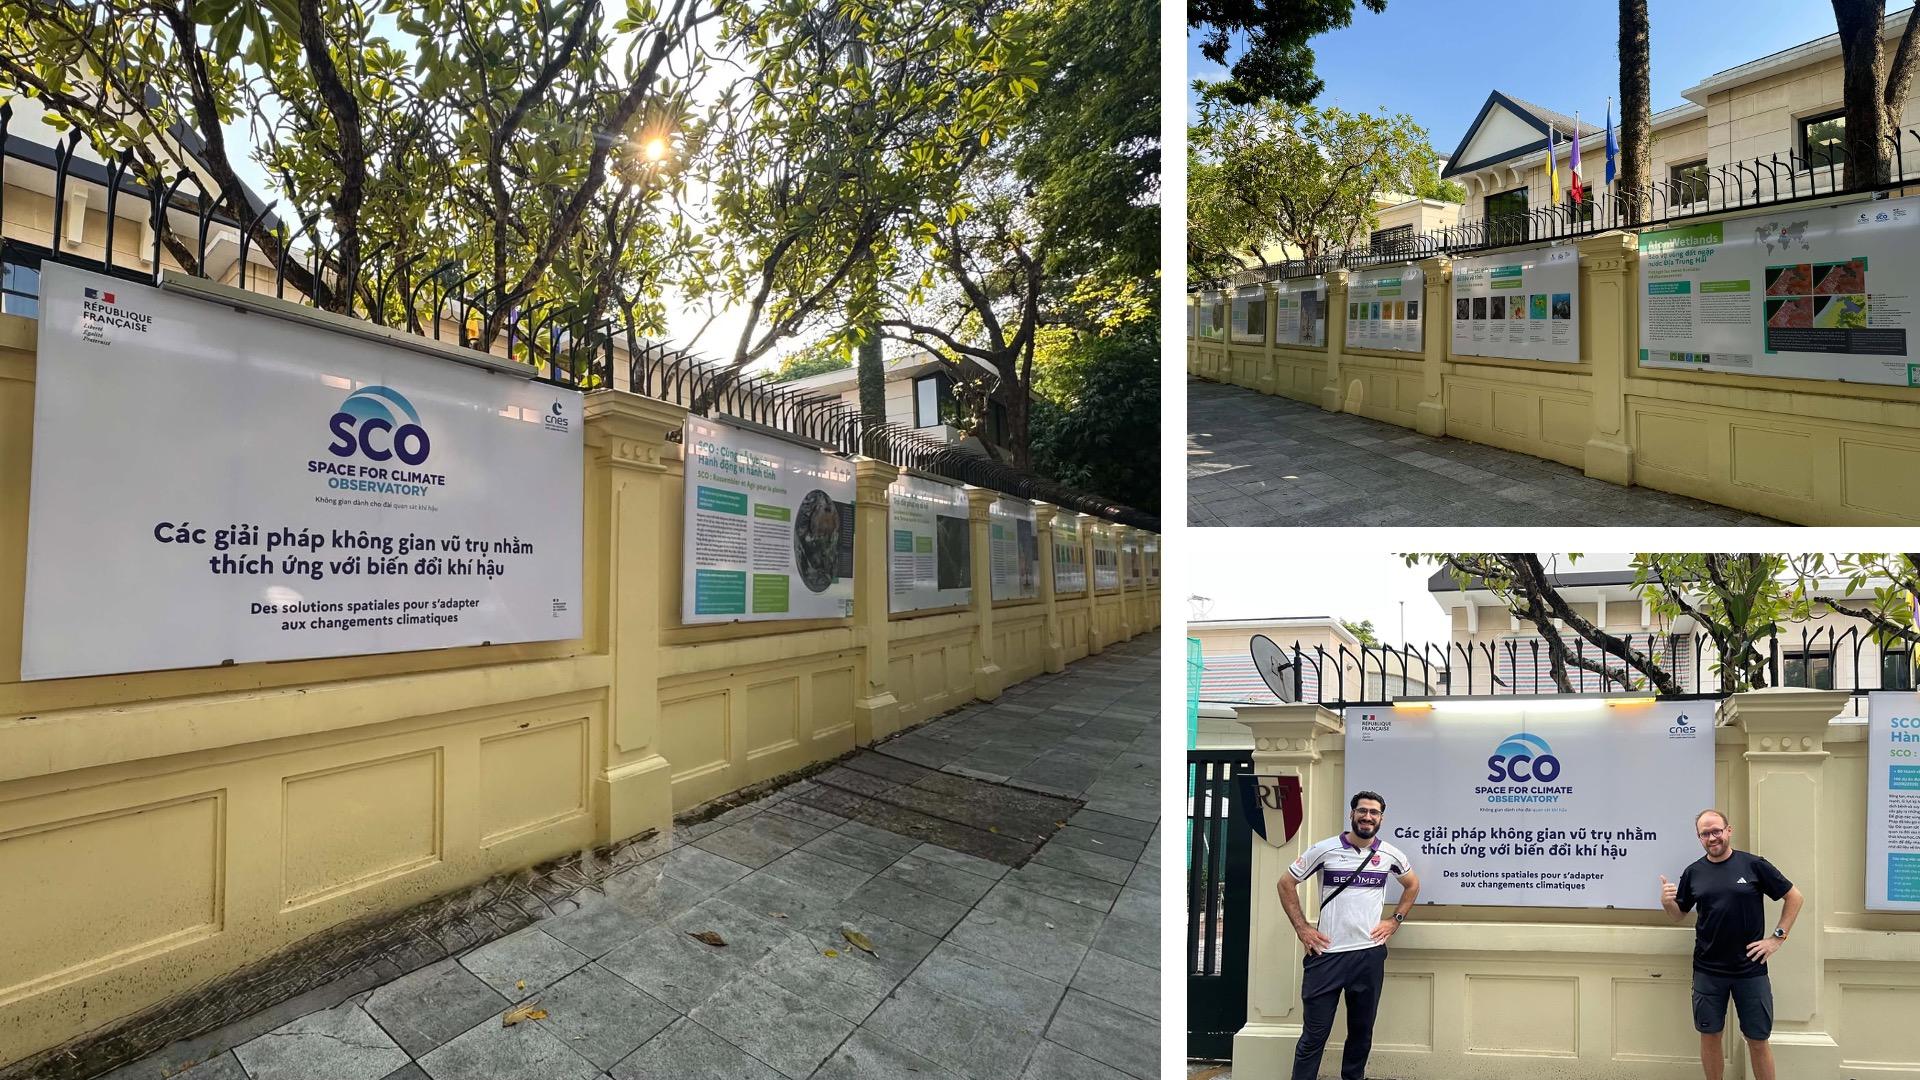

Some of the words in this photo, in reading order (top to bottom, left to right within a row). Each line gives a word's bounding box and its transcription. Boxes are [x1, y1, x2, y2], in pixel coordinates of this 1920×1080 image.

[1675, 258, 1694, 266] Trung
[84, 300, 152, 324] RÉPUBLIQUE
[83, 311, 148, 332] FRANÇAISE
[545, 415, 568, 426] cnes
[328, 412, 431, 466] SCO
[308, 460, 356, 477] SPACE
[360, 466, 388, 480] FOR
[391, 470, 446, 486] CLIMATE
[698, 455, 718, 468] Hành
[720, 459, 738, 474] động
[698, 470, 710, 479] SCO
[328, 478, 428, 496] OBSERVATORY
[315, 496, 337, 506] Không
[338, 498, 352, 506] gian
[353, 498, 368, 506] dành
[370, 500, 382, 508] cho
[154, 522, 207, 544] Các
[214, 524, 259, 550] giải
[267, 527, 325, 553] pháp
[332, 530, 394, 555] không
[399, 533, 436, 555] gian
[441, 535, 461, 552] vũ
[466, 538, 489, 557] trụ
[494, 536, 534, 554] nhằm
[210, 554, 274, 574] thích
[282, 554, 324, 580] ứng
[330, 556, 360, 575] với
[368, 556, 408, 575] biến
[414, 556, 442, 575] đổi
[448, 558, 472, 576] khí
[476, 558, 504, 580] hậu
[251, 602, 278, 614] Des
[282, 600, 344, 614] solutions
[347, 599, 400, 614] spatiales
[403, 601, 429, 613] pour
[282, 620, 306, 630] aux
[310, 616, 394, 630] changements
[396, 614, 458, 626] climatiques
[1670, 726, 1696, 734] cnes
[1488, 754, 1560, 782] SCO
[1251, 784, 1288, 810] RF
[1475, 786, 1506, 794] SPACE
[1508, 786, 1528, 794] FOR
[1530, 786, 1572, 794] CLIMATE
[1488, 795, 1558, 803] OBSERVATORY
[1394, 827, 1420, 838] Các
[1424, 826, 1448, 842] giải
[1452, 827, 1486, 842] pháp
[1490, 828, 1532, 842] không
[1537, 828, 1566, 842] gian
[1570, 828, 1586, 840] vũ
[1591, 829, 1612, 843] trụ
[1617, 826, 1656, 840] nhằm
[1422, 842, 1456, 854] thích
[1460, 843, 1486, 858] ứng
[1490, 844, 1510, 855] với
[1514, 843, 1544, 855] biến
[1549, 843, 1571, 856] đổi
[1576, 844, 1596, 856] khí
[1602, 844, 1627, 860] hậu
[1443, 870, 1458, 878] Des
[1460, 870, 1498, 878] solutions
[1501, 870, 1538, 880] spatiales
[1540, 872, 1560, 880] pour
[1478, 880, 1534, 890] changements
[1536, 881, 1586, 891] climatiques
